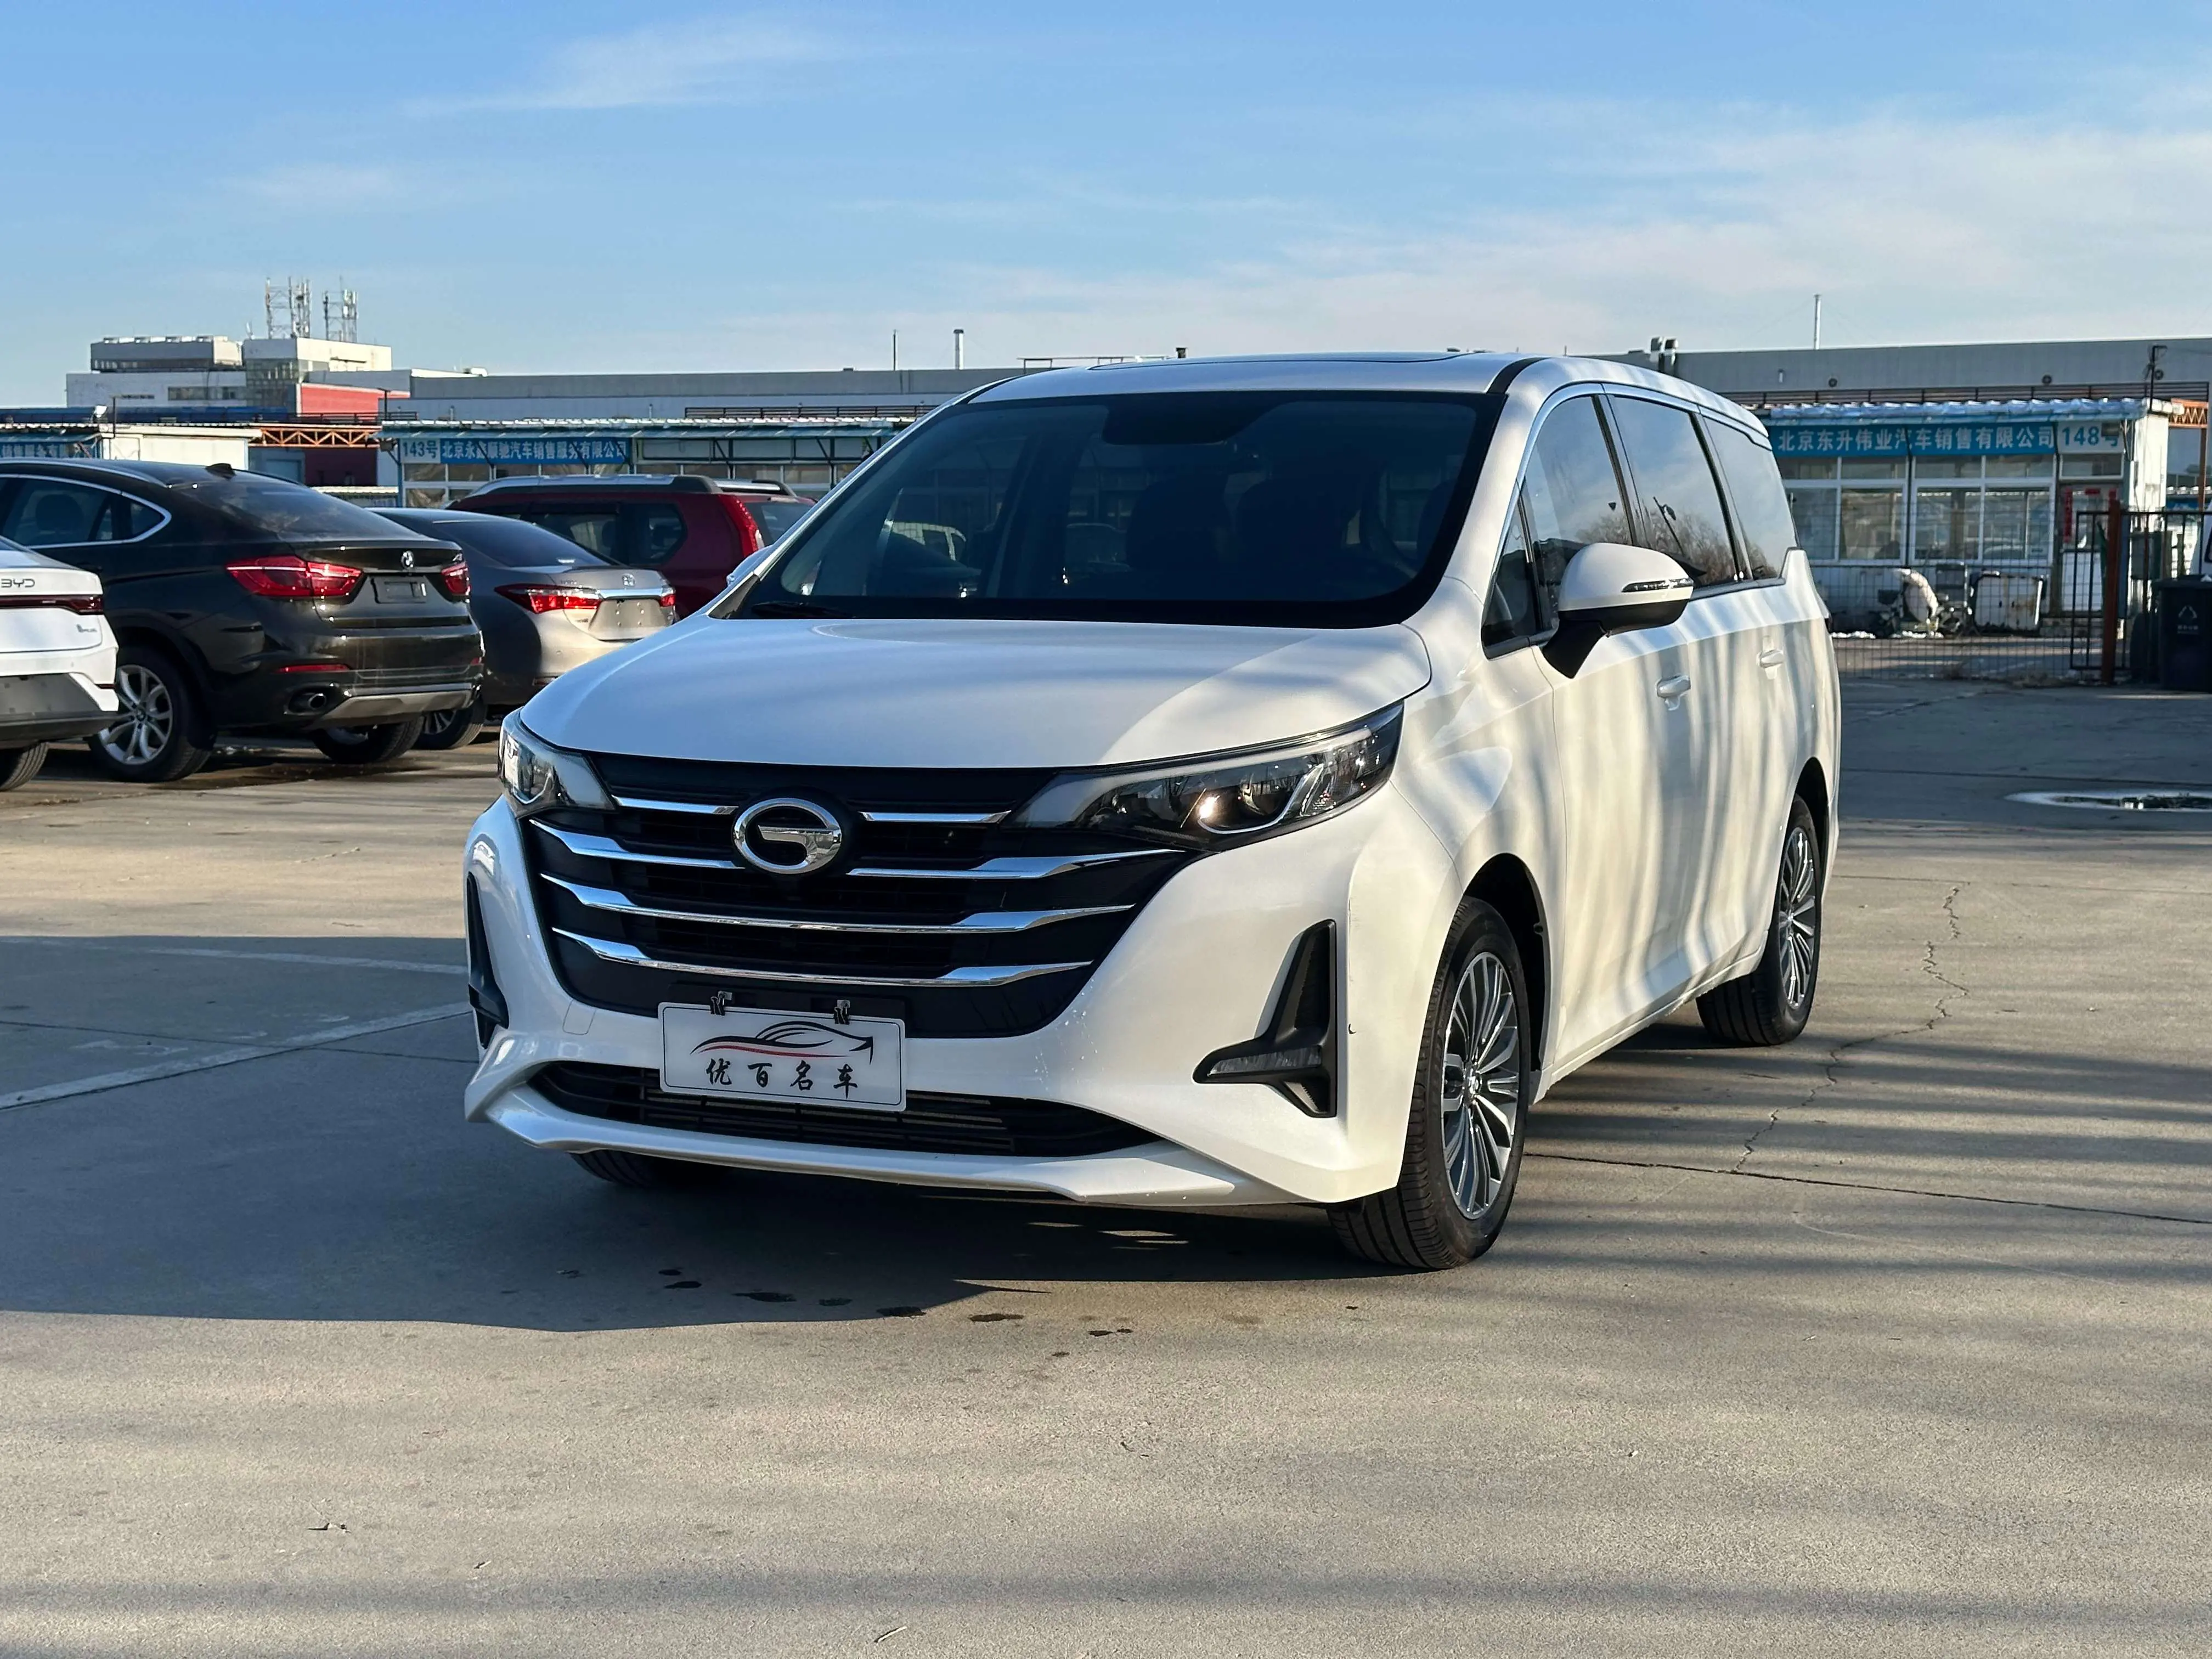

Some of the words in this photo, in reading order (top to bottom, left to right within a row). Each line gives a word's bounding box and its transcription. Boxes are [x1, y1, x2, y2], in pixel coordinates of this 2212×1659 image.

[403, 441, 438, 459] 143号
[1778, 426, 2054, 452] 北京东升伟业汽车销售有限公司
[1, 578, 36, 588] BYD
[706, 1058, 858, 1099] 优百名车
